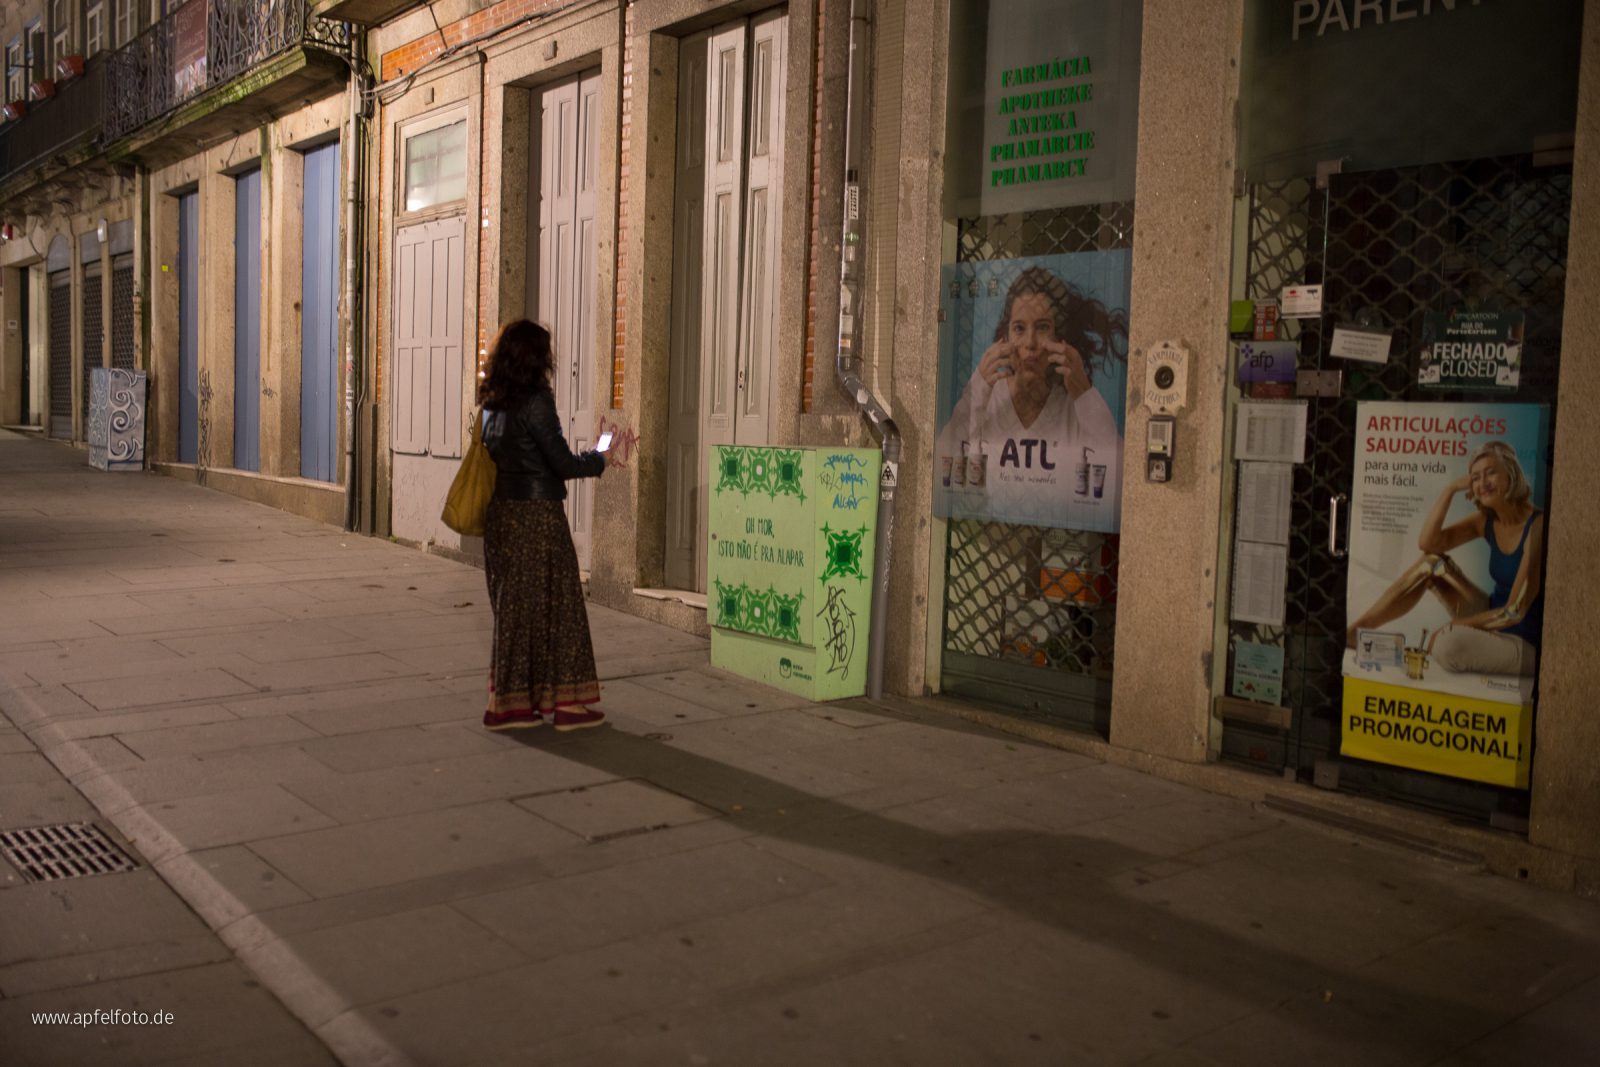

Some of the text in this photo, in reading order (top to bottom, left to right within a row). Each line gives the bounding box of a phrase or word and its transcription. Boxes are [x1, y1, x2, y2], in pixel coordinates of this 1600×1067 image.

[1292, 0, 1481, 41] PARE
[1001, 56, 1092, 88] FARMÁCIA
[998, 83, 1093, 115] APOTHEKE
[1008, 111, 1077, 136] ANTEKA
[990, 131, 1095, 163] PHAMARCIE
[991, 158, 1088, 187] PHAMARCY
[1250, 351, 1274, 371] afp
[1433, 342, 1507, 361] FECHADO
[1440, 360, 1498, 378] CLOSED
[1367, 415, 1507, 437] ARTICULAÇÕES
[1000, 438, 1056, 470] ATL
[1366, 436, 1468, 456] SAUDÁVEIS
[1365, 460, 1447, 474] para uma vida
[1364, 474, 1418, 487] mais fácil.
[746, 517, 775, 539] OH MOR,
[719, 539, 804, 567] ISTO NÃO É PRA ALAPAR
[1364, 696, 1507, 735] EMBALAGEM
[1350, 716, 1523, 761] PROMOCIONAL!
